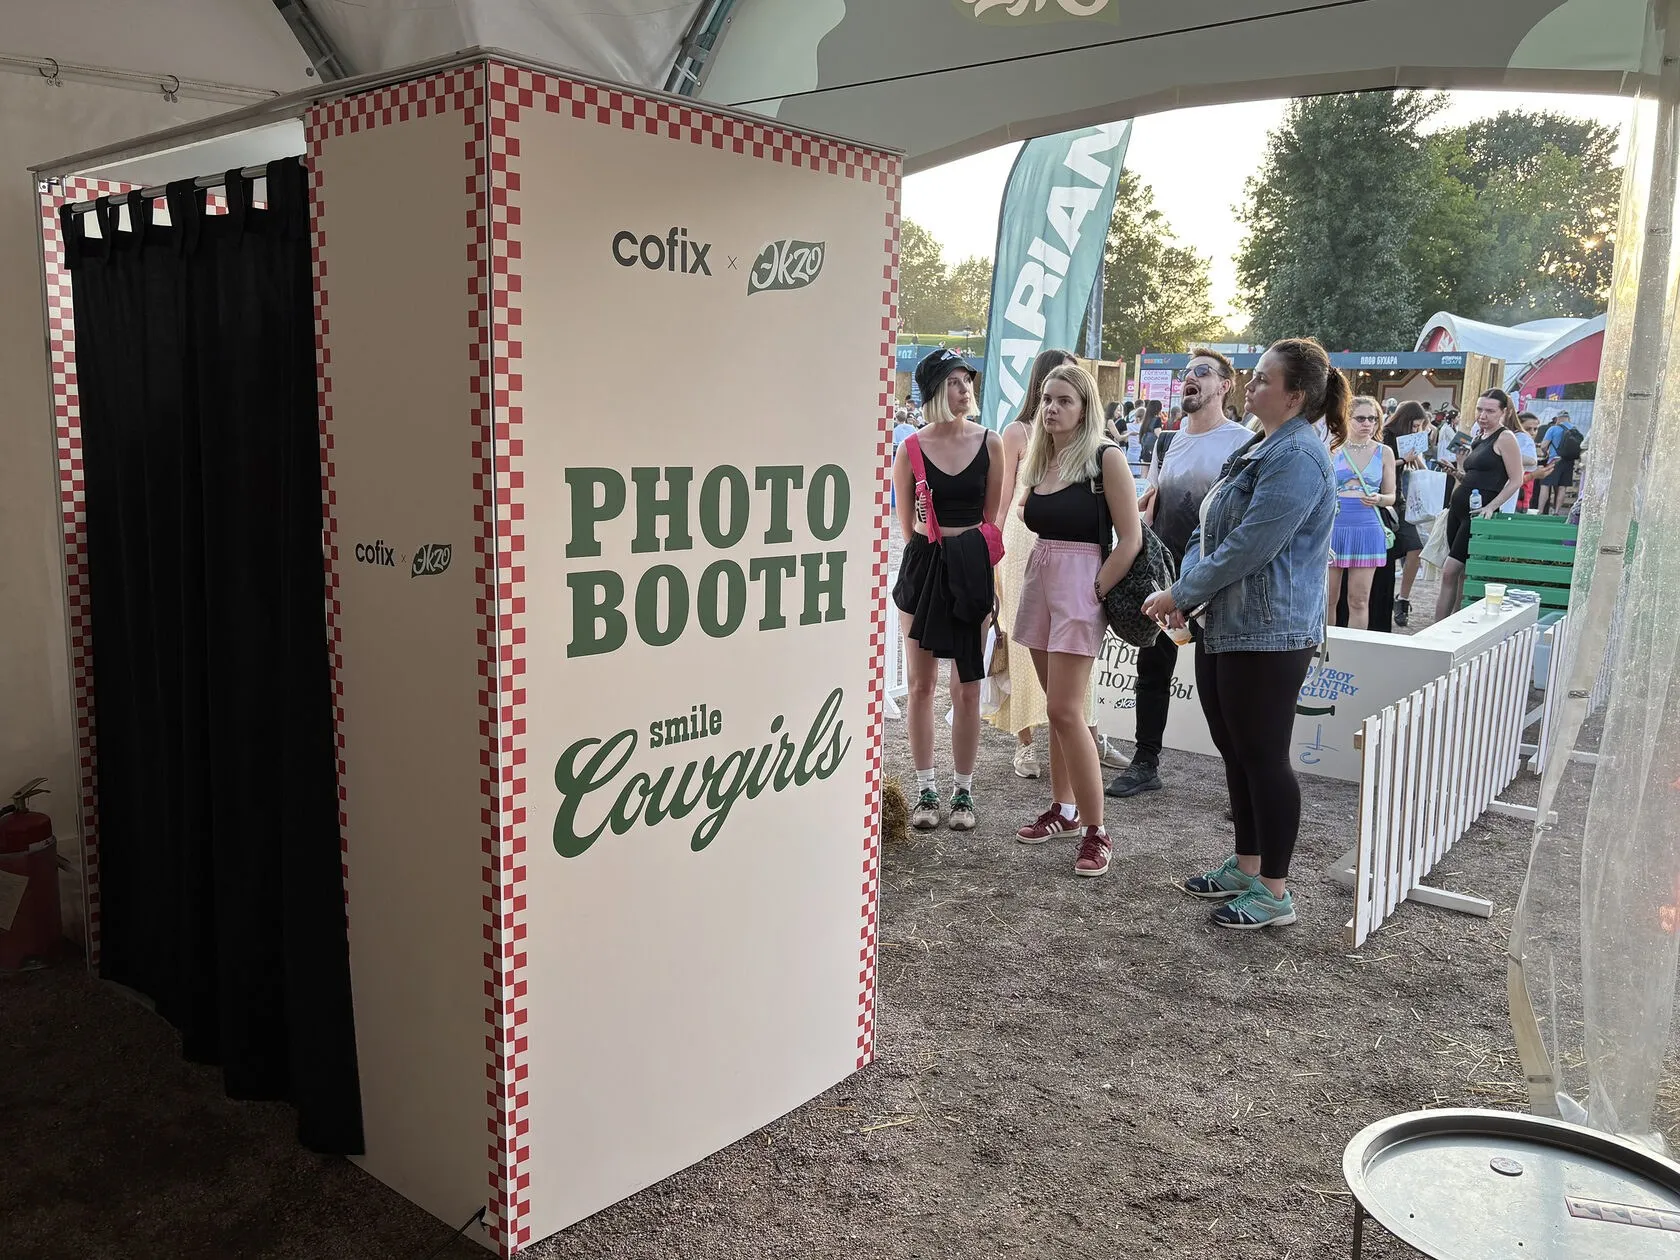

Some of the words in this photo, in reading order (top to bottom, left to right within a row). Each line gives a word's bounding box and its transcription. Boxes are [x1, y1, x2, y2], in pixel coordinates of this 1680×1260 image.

[612, 226, 712, 276] cofix
[1377, 356, 1398, 365] БУХАРА
[564, 463, 851, 558] PHOTO
[355, 540, 395, 567] cofix
[566, 550, 848, 659] BOOTH
[1098, 670, 1194, 700] подвы
[1300, 686, 1339, 700] CLUB
[1311, 678, 1359, 696] UNTRY
[650, 703, 722, 749] smile
[552, 687, 852, 859] Cowgirls
